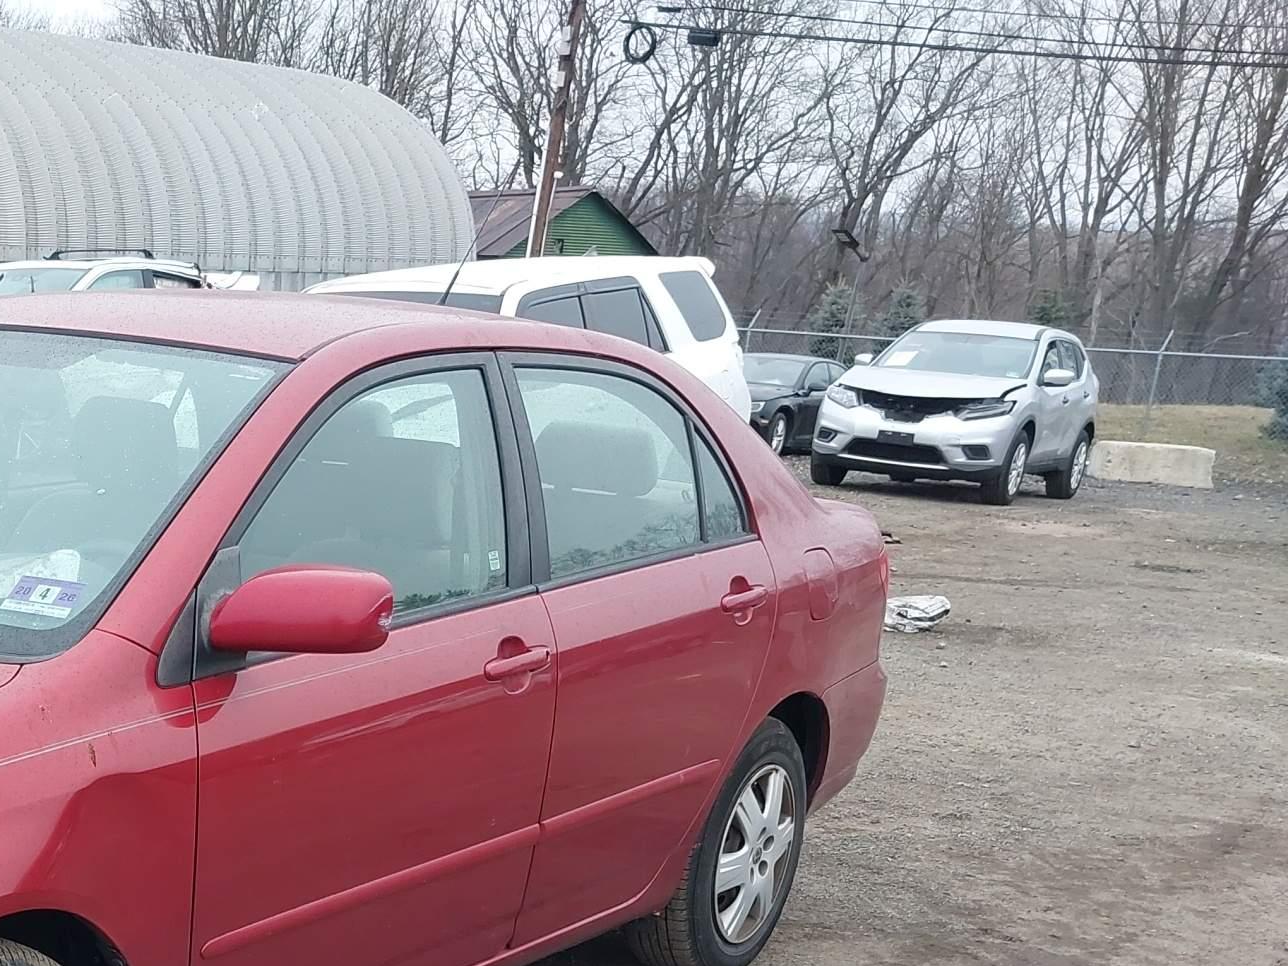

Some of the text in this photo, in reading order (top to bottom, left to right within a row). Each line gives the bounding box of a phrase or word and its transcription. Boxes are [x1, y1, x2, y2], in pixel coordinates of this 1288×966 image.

[15, 586, 77, 602] 20 4 26
